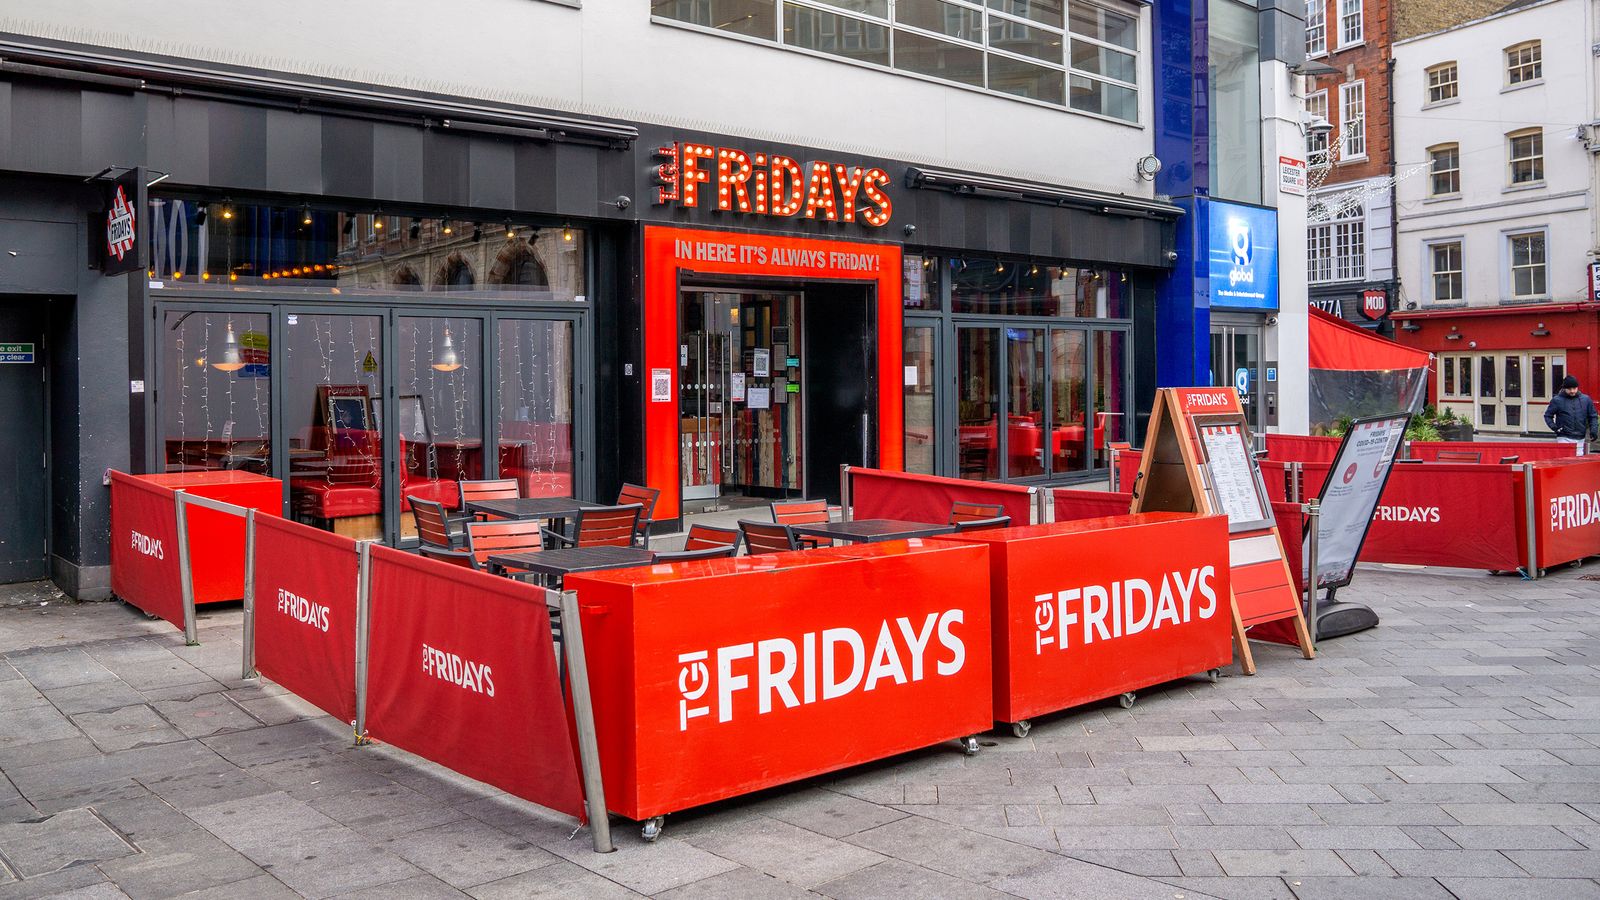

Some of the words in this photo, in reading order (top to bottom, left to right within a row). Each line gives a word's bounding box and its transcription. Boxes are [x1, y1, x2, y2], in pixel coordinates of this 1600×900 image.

[1282, 166, 1300, 177] LEICESTER
[1282, 175, 1296, 185] SQUARE
[675, 240, 692, 259] IN
[696, 242, 736, 262] HERE
[771, 247, 826, 268] ALWAYS
[1229, 266, 1254, 287] global
[1309, 299, 1342, 319] ZZA
[1365, 296, 1384, 310] MOD
[1191, 392, 1228, 406] FRIDAYS
[1550, 497, 1559, 532] TGI
[135, 531, 164, 560] FRIDAYS
[284, 590, 330, 633] FRIDAYS
[1034, 592, 1055, 655] TGI
[1057, 565, 1217, 650] FRIDAYS
[428, 646, 495, 698] FRIDAYS
[678, 650, 709, 732] TGI
[716, 608, 966, 724] FRIDAYS
